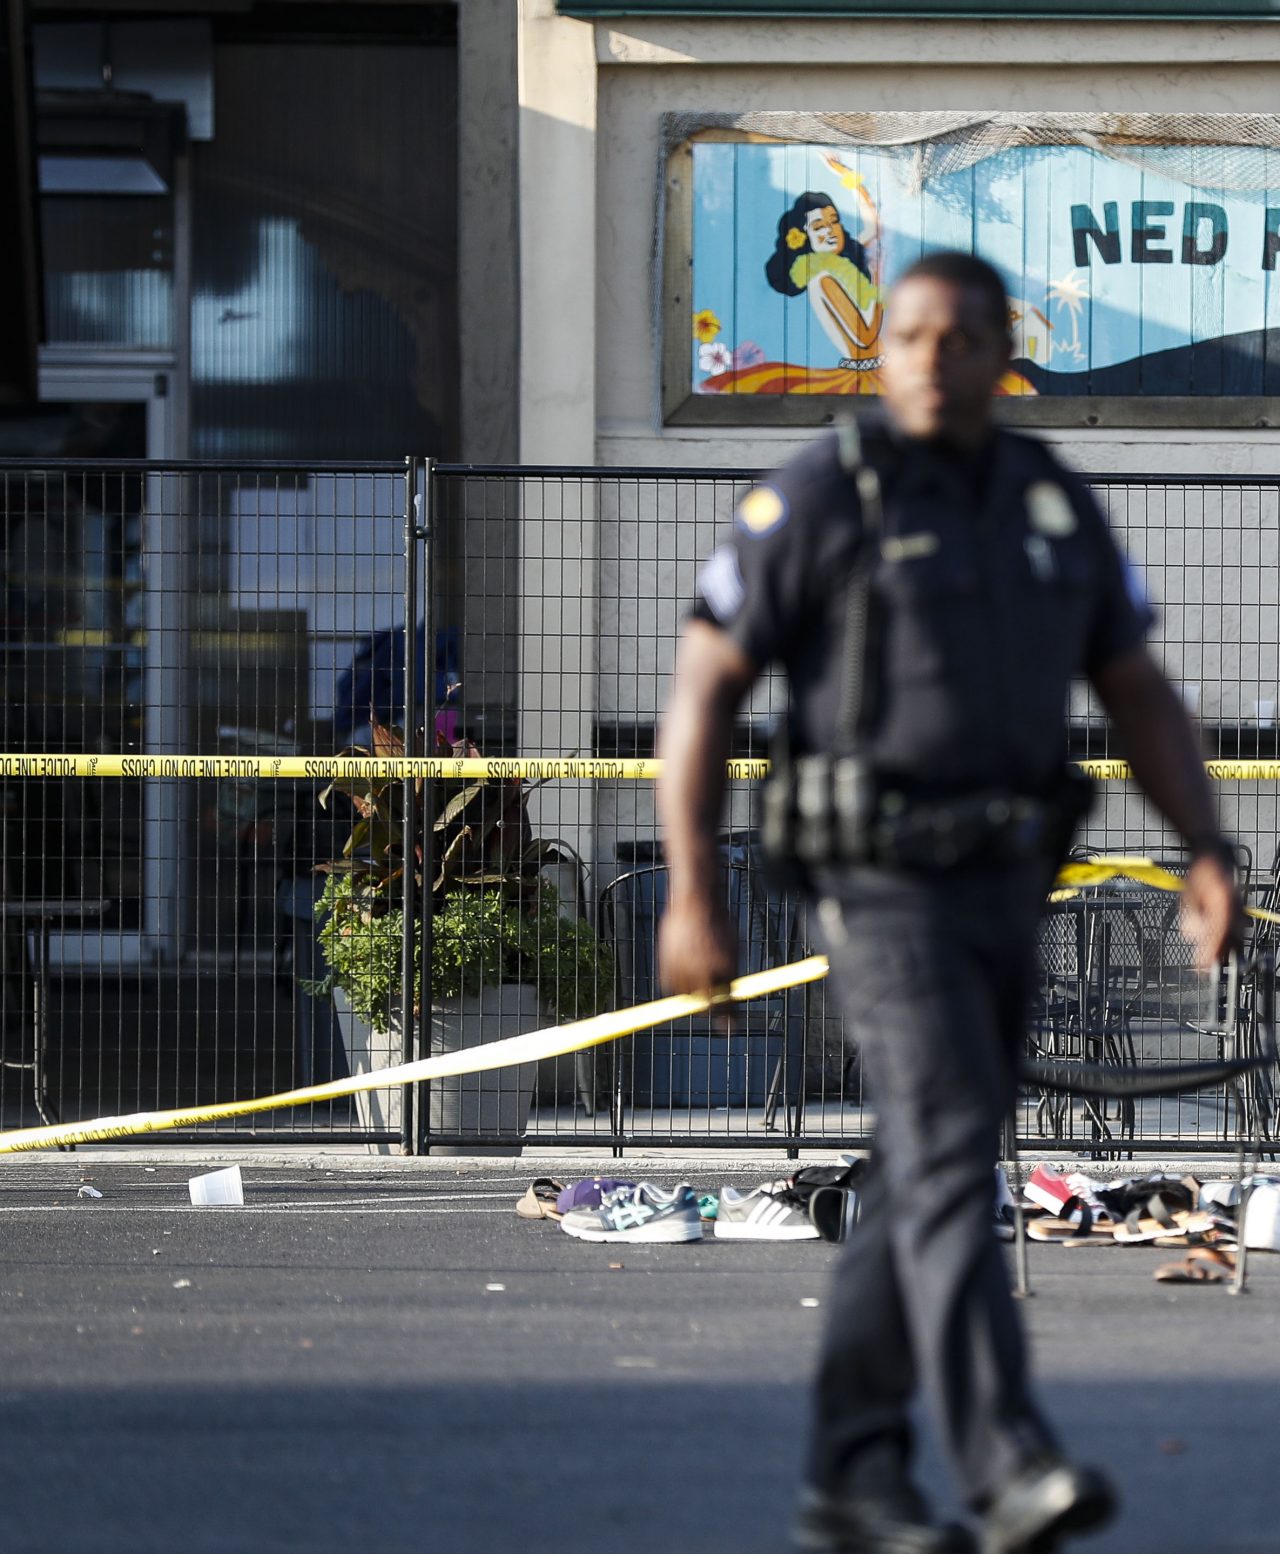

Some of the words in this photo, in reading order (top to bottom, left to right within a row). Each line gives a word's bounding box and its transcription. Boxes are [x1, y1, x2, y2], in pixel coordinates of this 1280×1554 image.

[1071, 201, 1229, 267] NED
[16, 758, 37, 777] LINE
[41, 758, 76, 777] POLICE
[122, 759, 155, 777] CROSS
[160, 759, 178, 777] NOT
[182, 759, 195, 777] DO
[200, 759, 221, 777] LINE
[225, 759, 260, 777] POLICE
[305, 760, 338, 778] CROSS
[344, 760, 361, 778] NOT
[365, 760, 378, 778] DO
[382, 760, 404, 778] LINE
[408, 760, 442, 778] POLICE
[488, 762, 520, 778] CROSS
[525, 762, 543, 778] NOT
[547, 762, 560, 778] DO
[564, 762, 586, 778] LINE
[590, 762, 624, 778] POLICE
